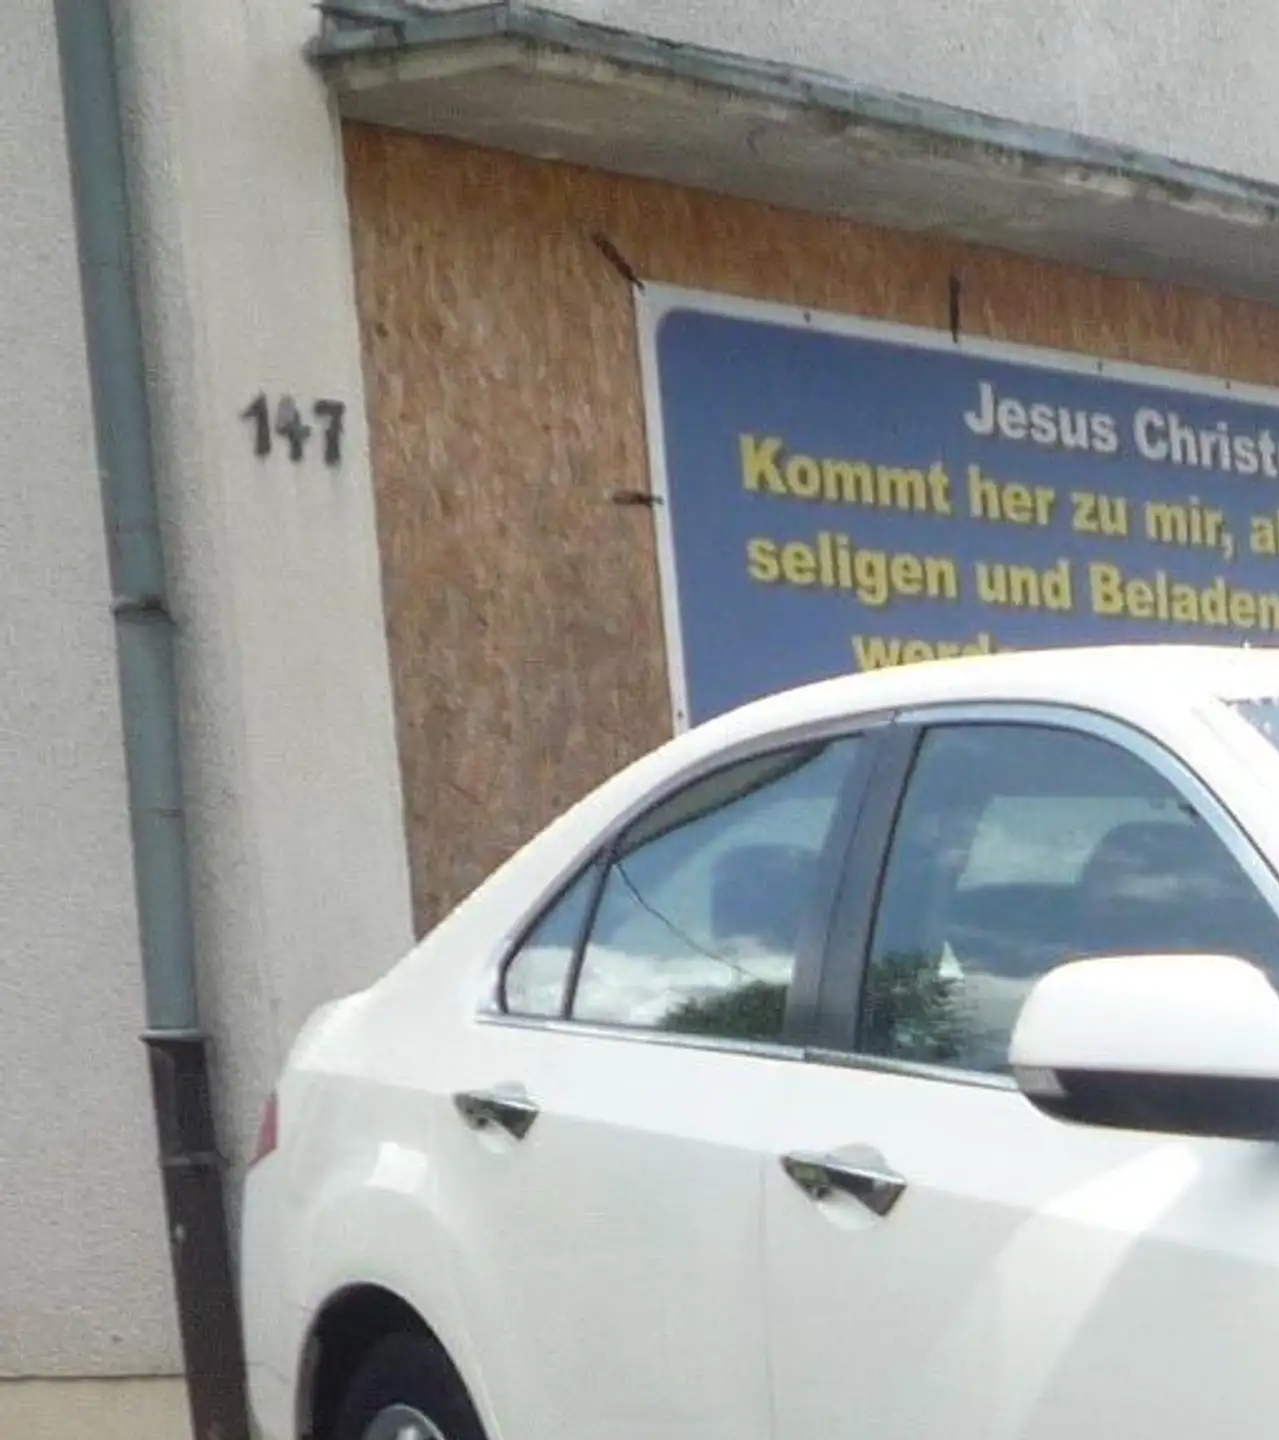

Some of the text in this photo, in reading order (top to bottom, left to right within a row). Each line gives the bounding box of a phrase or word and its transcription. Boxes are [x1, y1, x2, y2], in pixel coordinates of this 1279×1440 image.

[242, 392, 346, 465] 147
[965, 382, 1118, 452] Jesus
[739, 433, 950, 515] Kommt
[968, 466, 1054, 526] her
[1071, 490, 1128, 536] zu
[1146, 497, 1233, 560] mir,
[747, 531, 957, 604] seligen
[974, 560, 1072, 610] und
